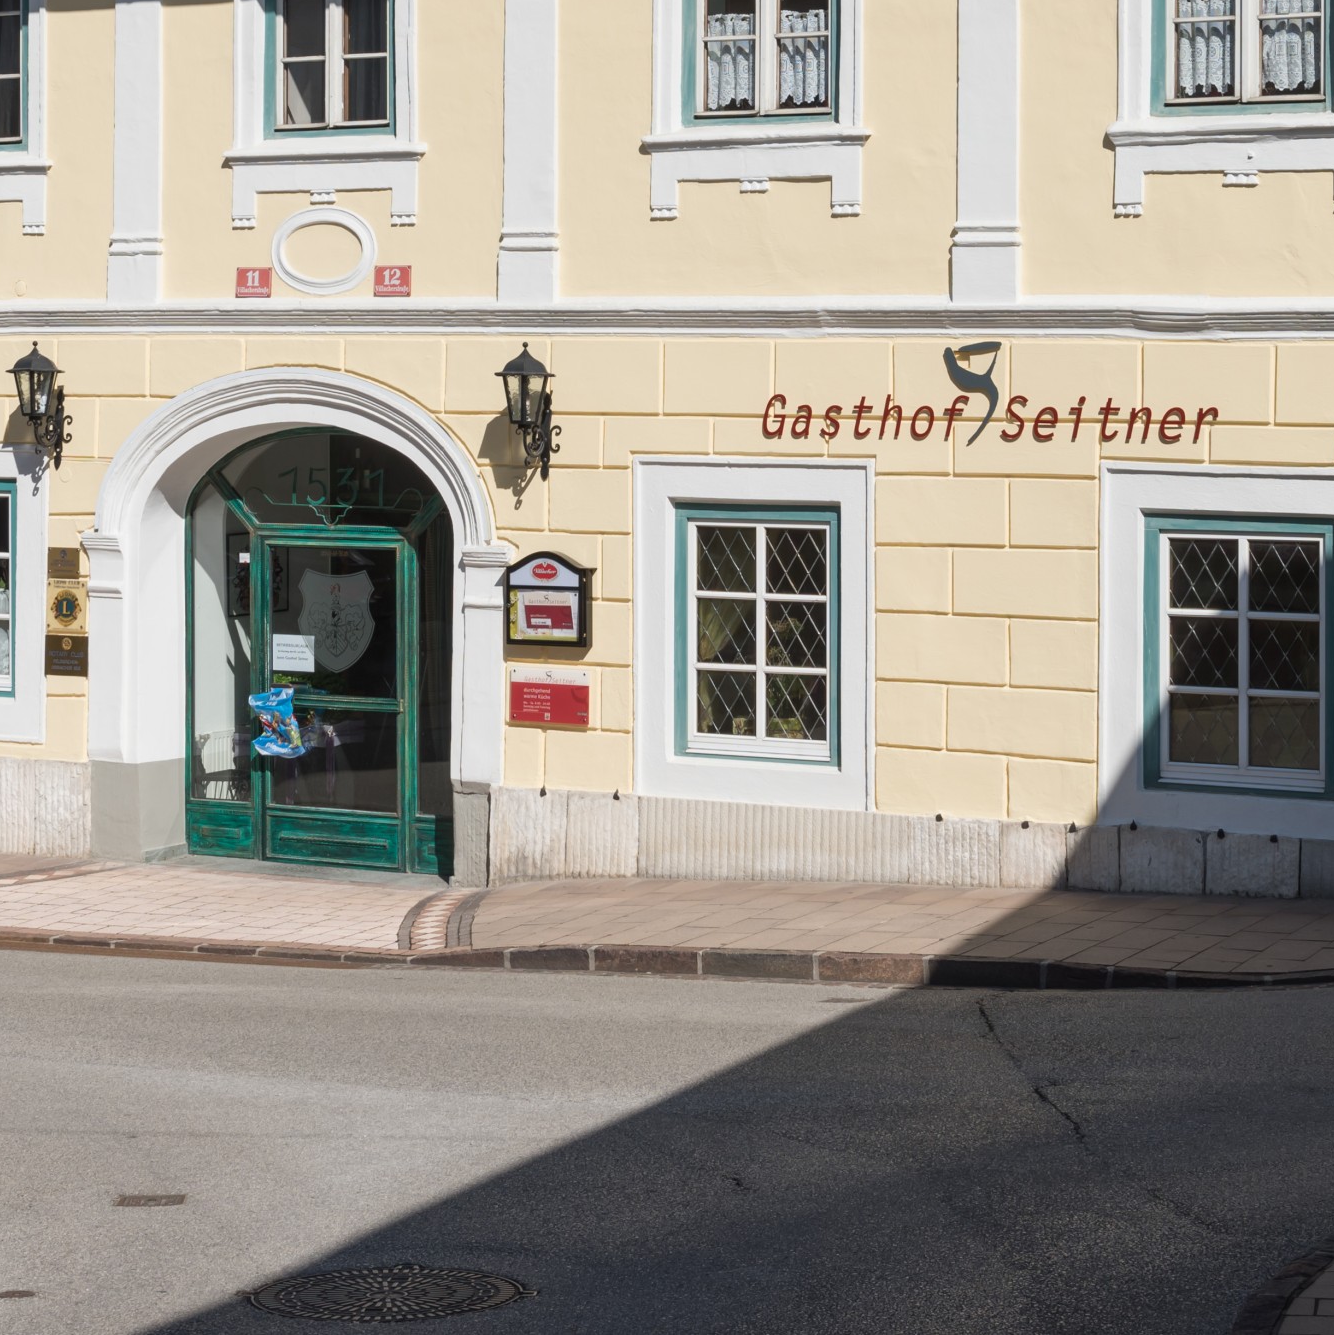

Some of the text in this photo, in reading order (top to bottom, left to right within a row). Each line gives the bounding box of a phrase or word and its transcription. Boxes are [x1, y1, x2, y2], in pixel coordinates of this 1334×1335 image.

[246, 270, 260, 286] 11
[383, 268, 401, 285] 12
[762, 394, 1219, 444] Gasthof Seitner
[278, 466, 384, 507] 1531
[62, 600, 70, 615] L
